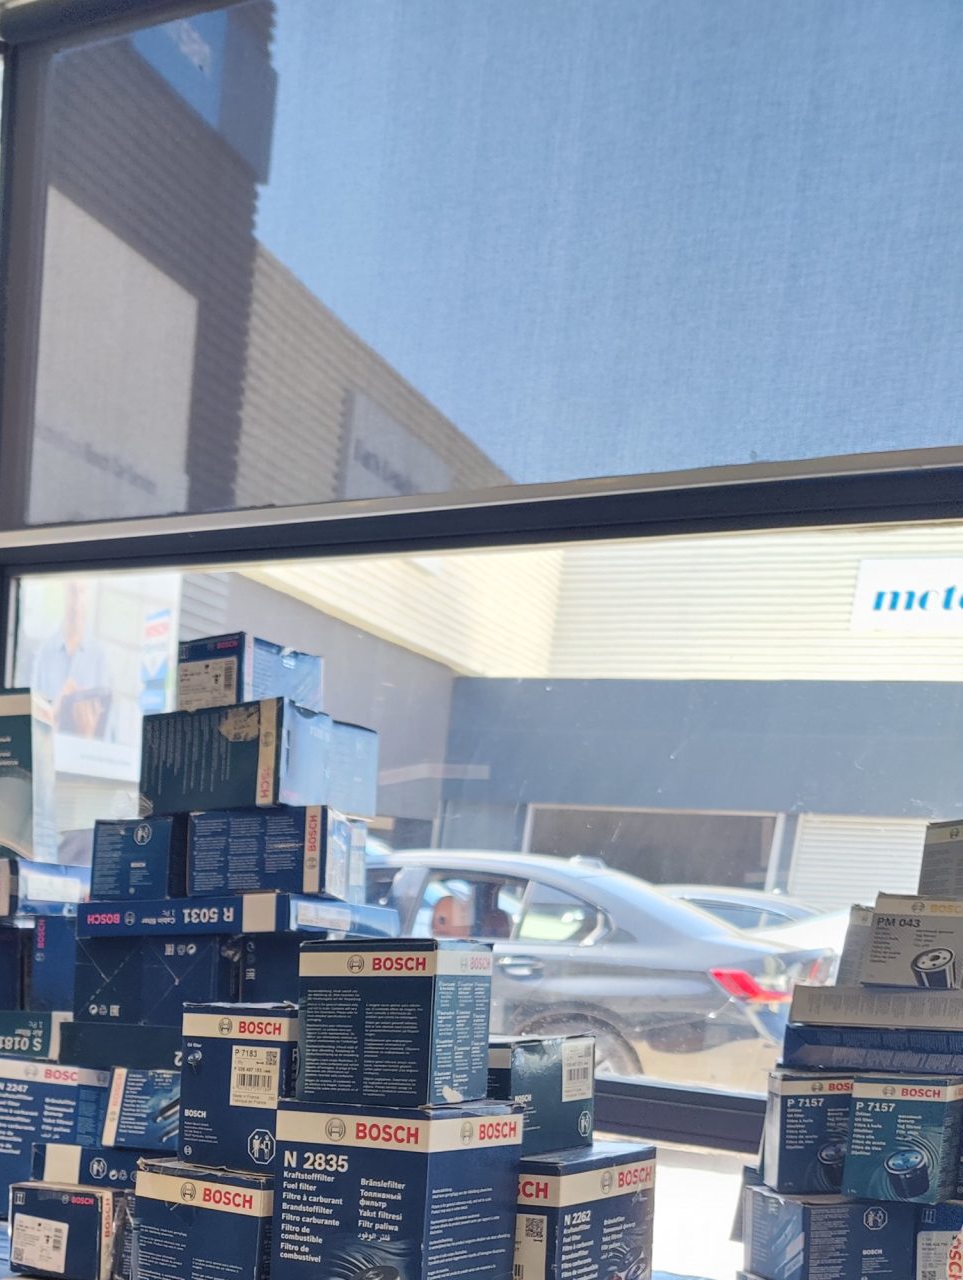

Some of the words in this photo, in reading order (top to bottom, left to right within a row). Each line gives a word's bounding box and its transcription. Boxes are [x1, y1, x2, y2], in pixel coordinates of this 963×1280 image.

[872, 585, 963, 611] met
[308, 815, 317, 852] BOSCH
[87, 913, 121, 925] BOSCH
[183, 907, 219, 924] 5031
[222, 907, 234, 921] R
[876, 917, 896, 928] PM
[899, 918, 921, 928] 043
[372, 957, 426, 971] BOSCH
[470, 956, 490, 970] BOSCH
[239, 1021, 282, 1036] BOSCH
[33, 1038, 42, 1051] S
[234, 1049, 240, 1057] P
[241, 1050, 258, 1058] 7183
[44, 1068, 78, 1082] BOSC
[901, 1088, 941, 1099] BOSCH
[787, 1099, 795, 1108] P
[798, 1098, 824, 1108] 7157
[855, 1101, 864, 1111] P
[867, 1102, 896, 1113] 7157
[184, 1109, 207, 1119] BOSCH
[356, 1122, 419, 1145] BOSCH
[478, 1121, 517, 1141] BOSCH
[284, 1151, 297, 1168] N
[303, 1152, 349, 1173] 2835
[618, 1166, 652, 1188] BOSCH
[283, 1181, 298, 1190] Fuel
[299, 1182, 317, 1192] filter
[360, 1178, 406, 1190] Bränslefilter
[71, 1197, 95, 1205] BOSCH
[203, 1186, 253, 1210] BOSCH
[282, 1191, 300, 1201] Filtre
[307, 1194, 343, 1206] carburant
[282, 1202, 333, 1215] Brandstoffilter
[281, 1212, 299, 1222] Filtro
[301, 1216, 340, 1227] carburante
[377, 1210, 403, 1221] filtresi
[564, 1214, 571, 1226] N
[572, 1210, 591, 1223] 2262
[281, 1223, 299, 1233] Filtro
[300, 1225, 311, 1234] de
[358, 1220, 374, 1230] Filtr
[374, 1222, 399, 1232] paliwa
[280, 1232, 323, 1244] combustible
[280, 1243, 298, 1252] Filtro
[300, 1245, 310, 1253] de
[862, 1248, 883, 1256] BOSCH
